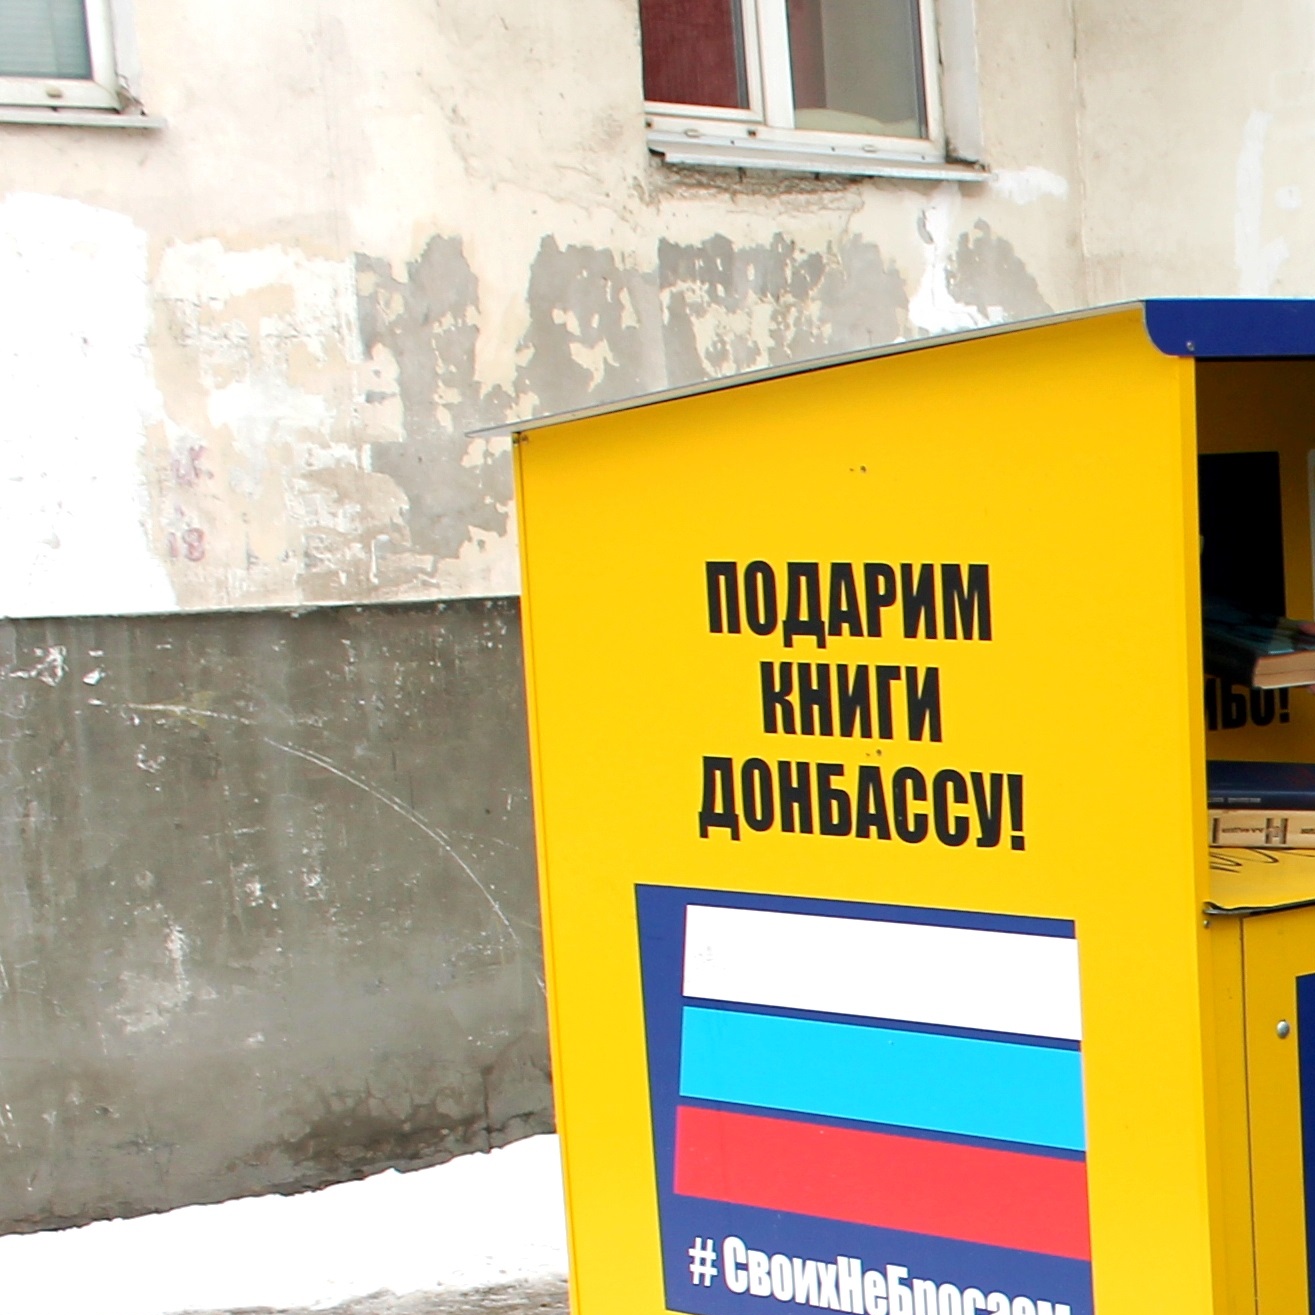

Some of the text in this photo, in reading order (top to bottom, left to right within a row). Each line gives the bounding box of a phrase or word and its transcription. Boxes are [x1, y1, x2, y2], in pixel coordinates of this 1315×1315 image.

[705, 559, 993, 650] ПОДАРИМ
[759, 660, 944, 743] КНИГИ
[697, 755, 1027, 851] ДОНБАССУ!
